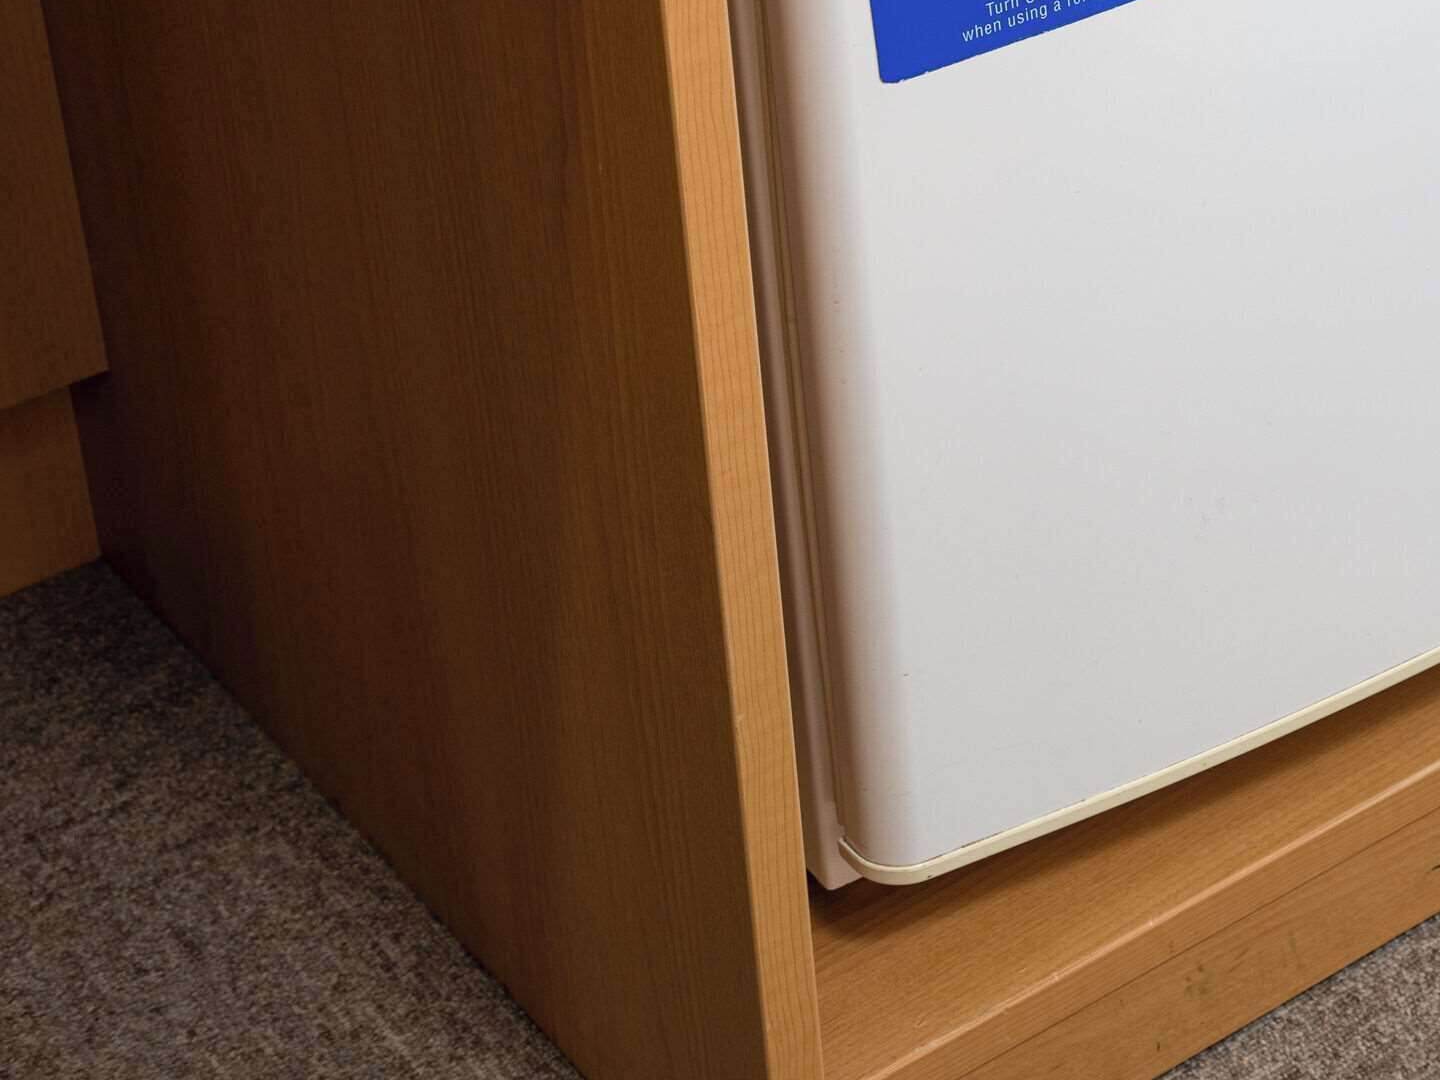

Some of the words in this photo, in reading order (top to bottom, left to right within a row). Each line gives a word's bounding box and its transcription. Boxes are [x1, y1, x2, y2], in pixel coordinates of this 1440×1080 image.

[962, 20, 1001, 42] when
[1008, 5, 1048, 27] using
[1053, 0, 1062, 12] a
